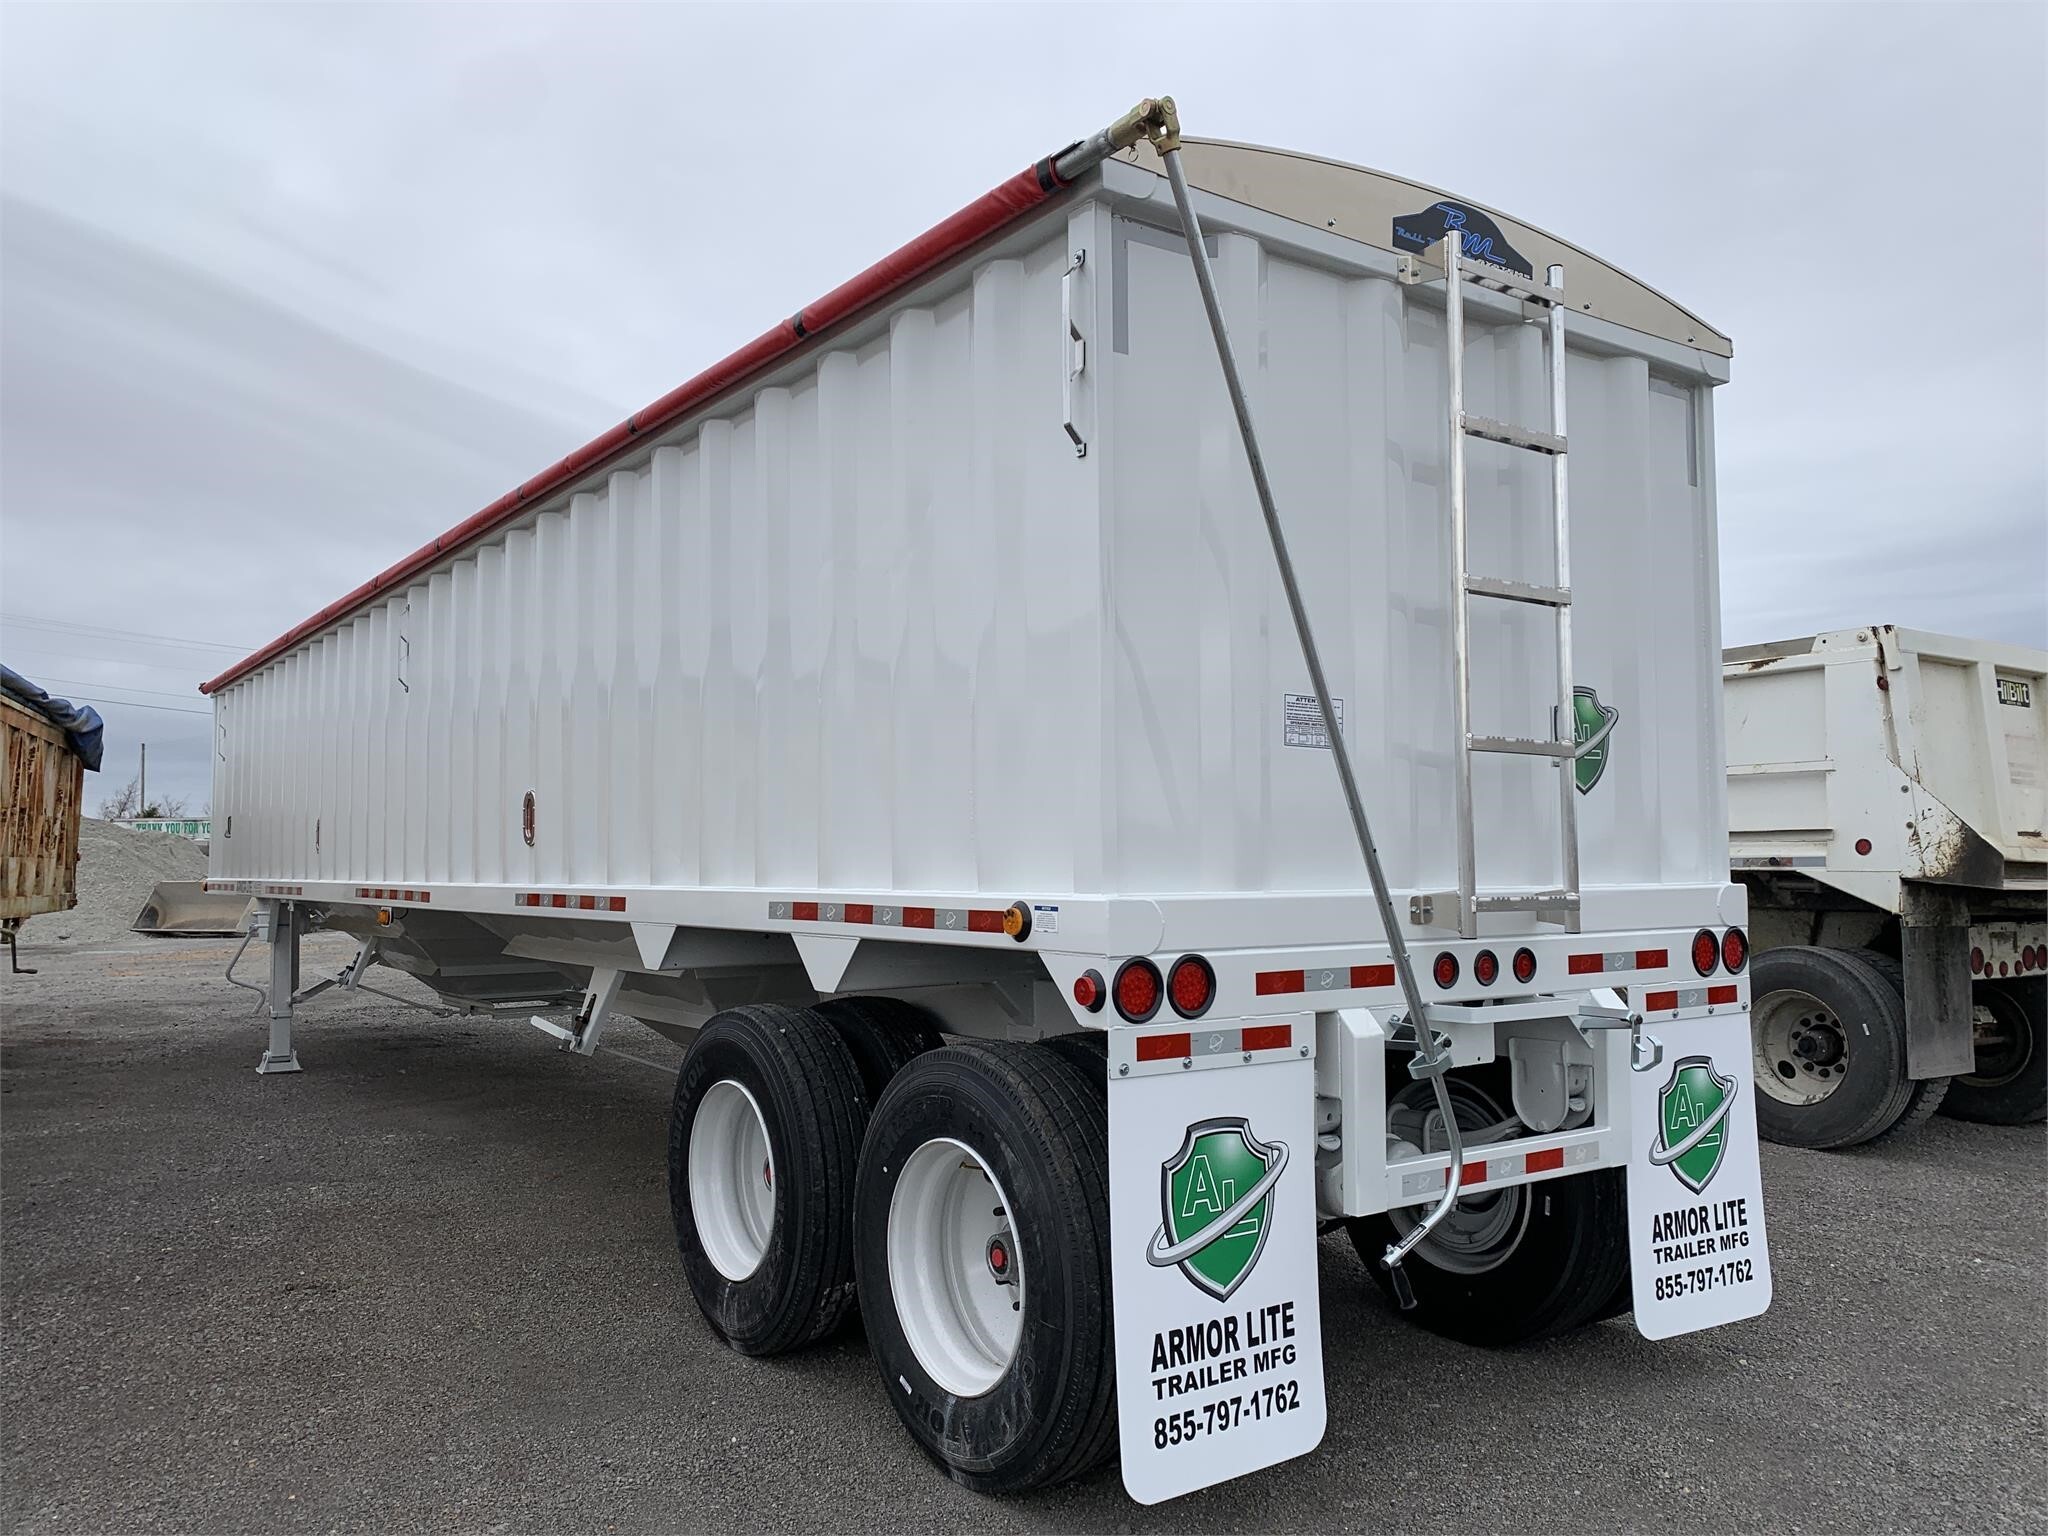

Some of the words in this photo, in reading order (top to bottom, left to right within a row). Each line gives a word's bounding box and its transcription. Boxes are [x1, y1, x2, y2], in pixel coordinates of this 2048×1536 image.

[165, 823, 180, 834] YOU
[184, 823, 199, 834] FOR
[202, 823, 211, 834] YO
[1670, 1083, 1720, 1148] AL
[1181, 1154, 1259, 1239] AL
[1652, 1205, 1711, 1244] ARMOR
[1713, 1198, 1748, 1231] LITE
[1653, 1237, 1717, 1265] TRAILER
[1719, 1230, 1750, 1252] MFG
[1655, 1258, 1754, 1301] 855-797-1762
[1150, 1315, 1240, 1373] ARMOR
[1246, 1301, 1296, 1349] LITE
[1151, 1357, 1248, 1401] TRAILER
[1253, 1343, 1297, 1374] MFG
[1153, 1379, 1300, 1450] 855-797-1762
